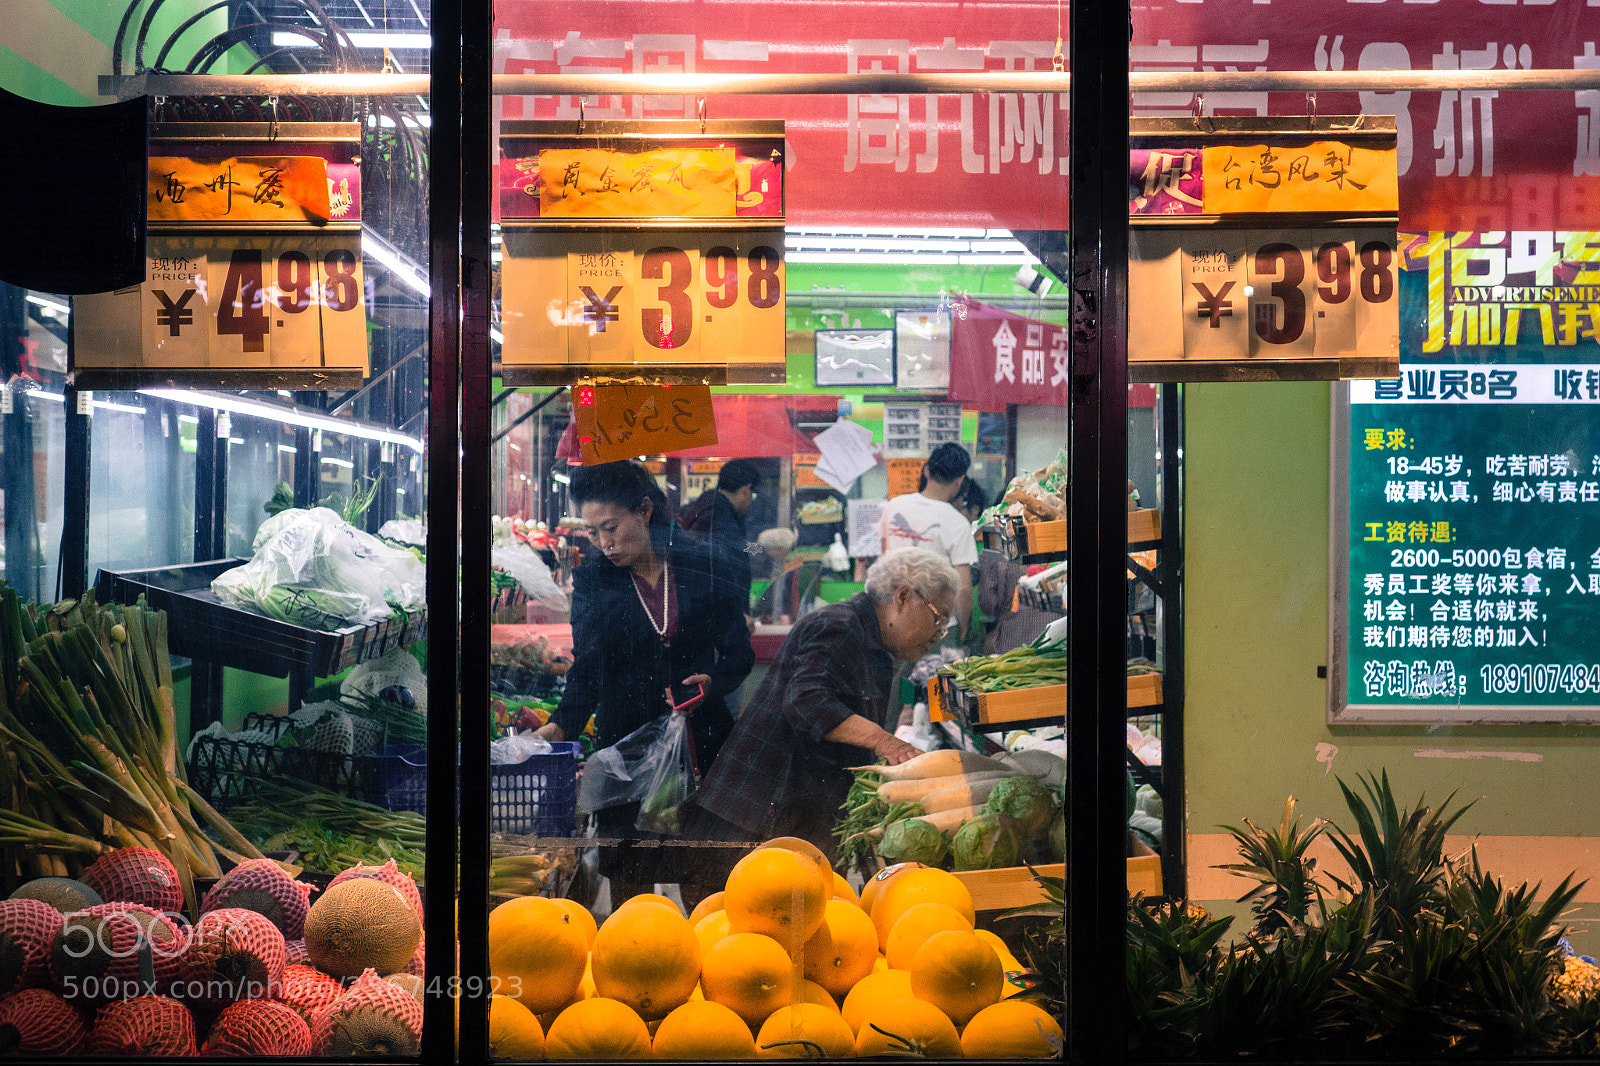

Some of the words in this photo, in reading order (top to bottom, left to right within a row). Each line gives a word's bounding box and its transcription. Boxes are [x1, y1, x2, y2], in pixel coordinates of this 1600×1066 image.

[152, 273, 195, 281] PRICE
[1192, 265, 1236, 273] PRICE
[217, 249, 359, 352] 4.98
[641, 245, 780, 349] 3.98
[1254, 240, 1393, 344] 3.98
[1363, 428, 1415, 450] 要求：
[1363, 521, 1457, 543] 工资待遇：
[1363, 626, 1547, 648] 我们期待您的加入！
